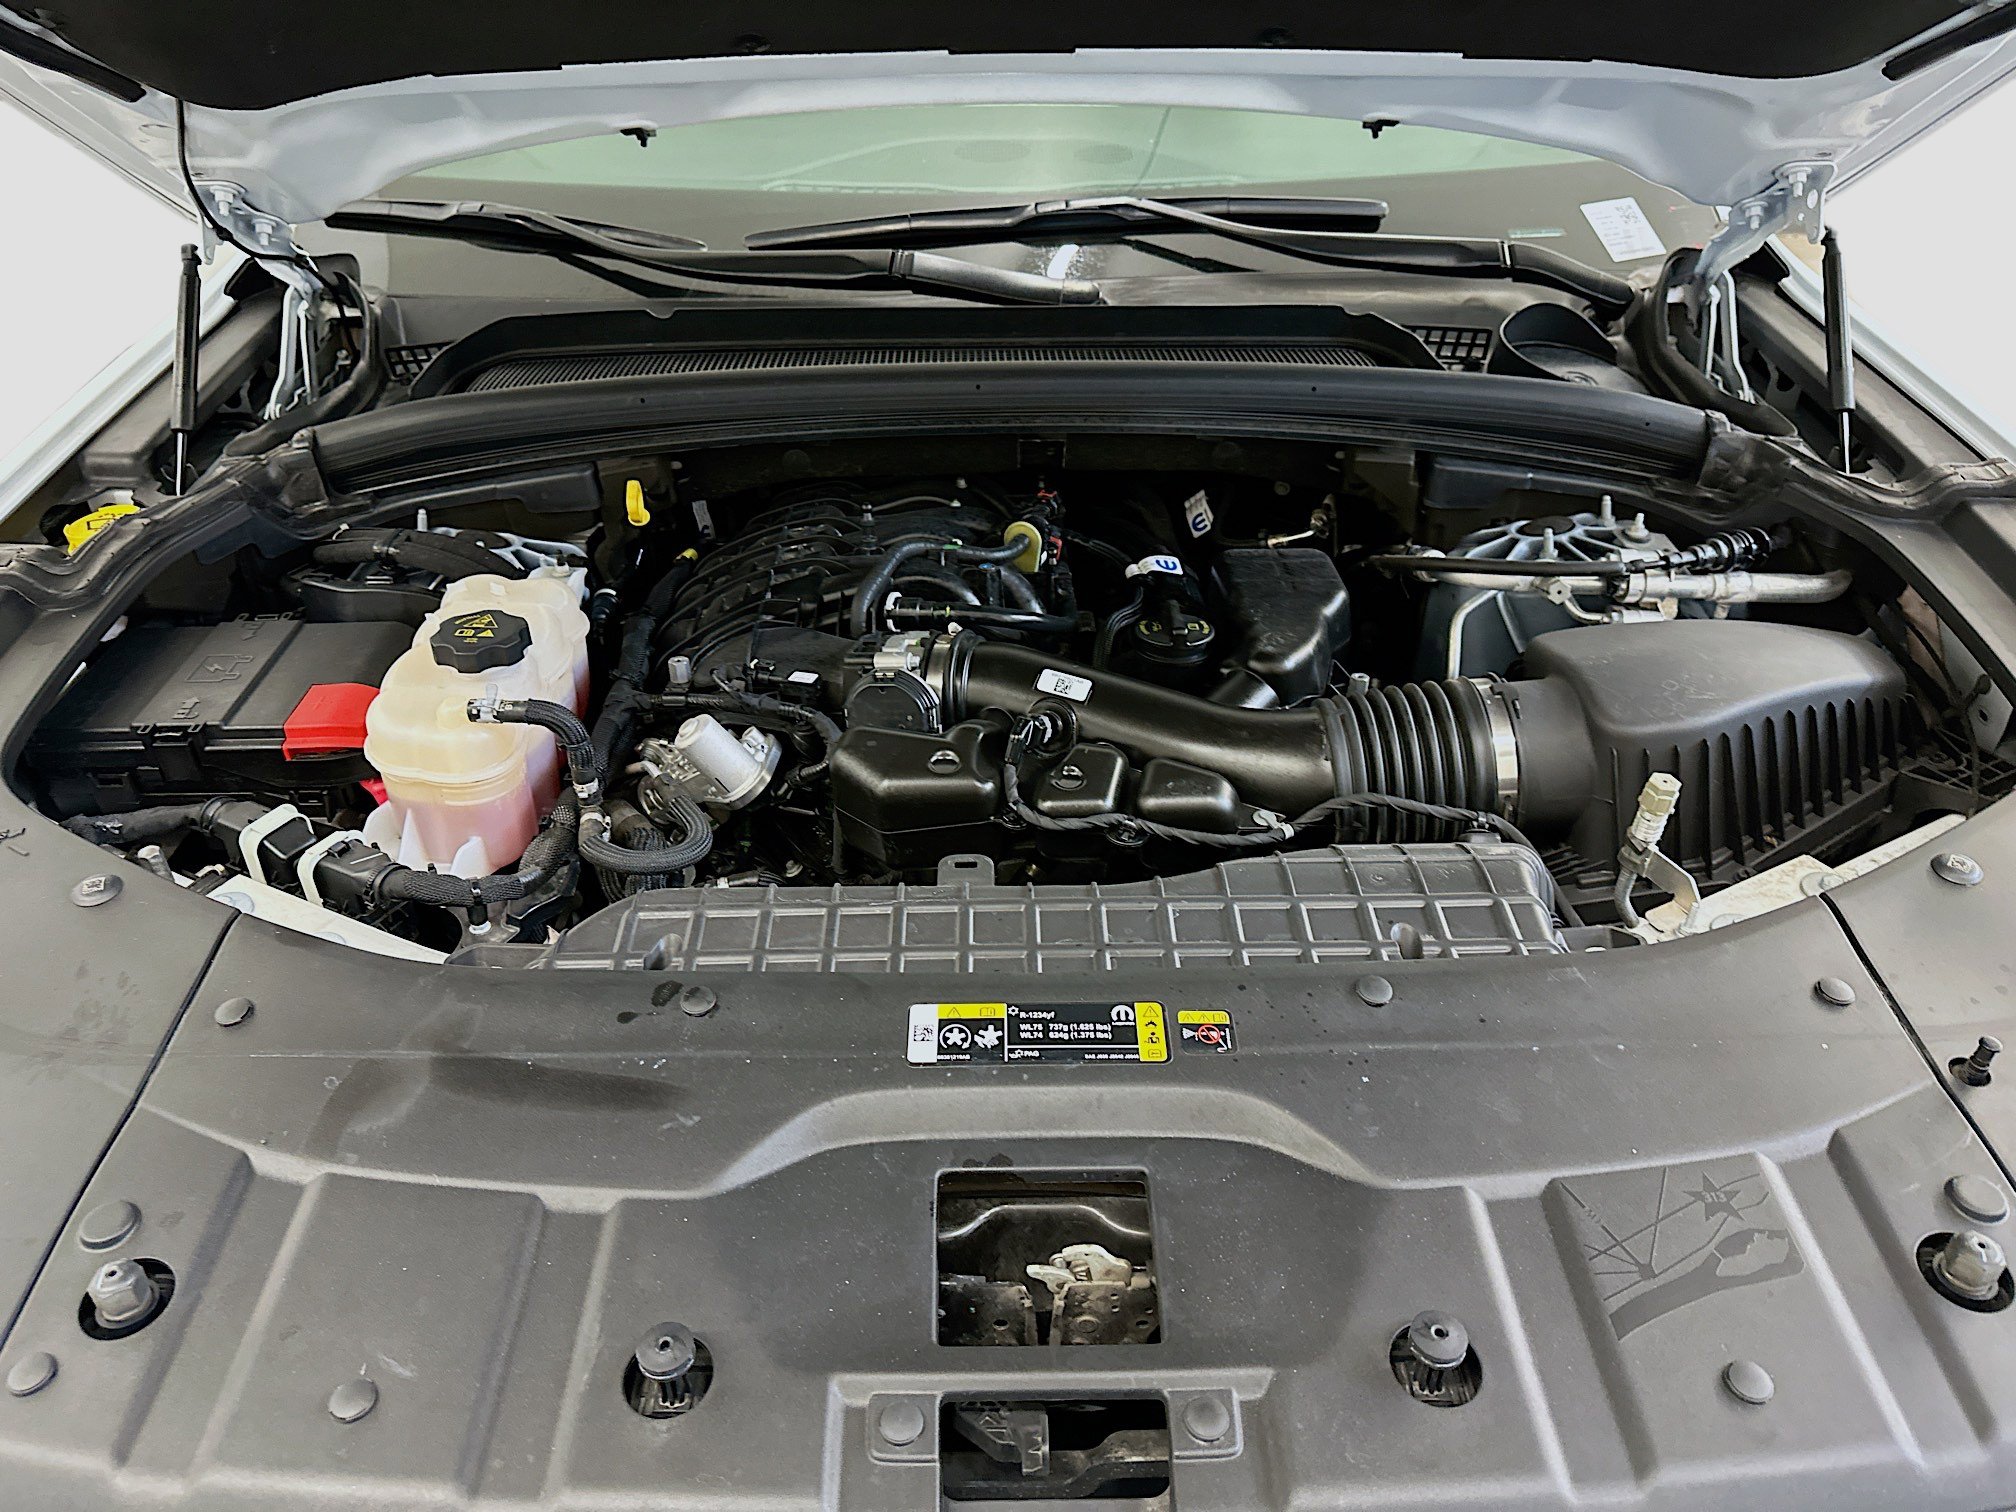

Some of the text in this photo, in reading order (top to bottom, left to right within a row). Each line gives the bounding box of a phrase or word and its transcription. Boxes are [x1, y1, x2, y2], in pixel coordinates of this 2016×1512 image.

[1019, 1011, 1055, 1020] R-1234yf
[1048, 1023, 1069, 1032] 737g
[1095, 1023, 1112, 1032] lbs)
[1019, 1031, 1044, 1039] WL74
[1095, 1031, 1113, 1040] lbs)
